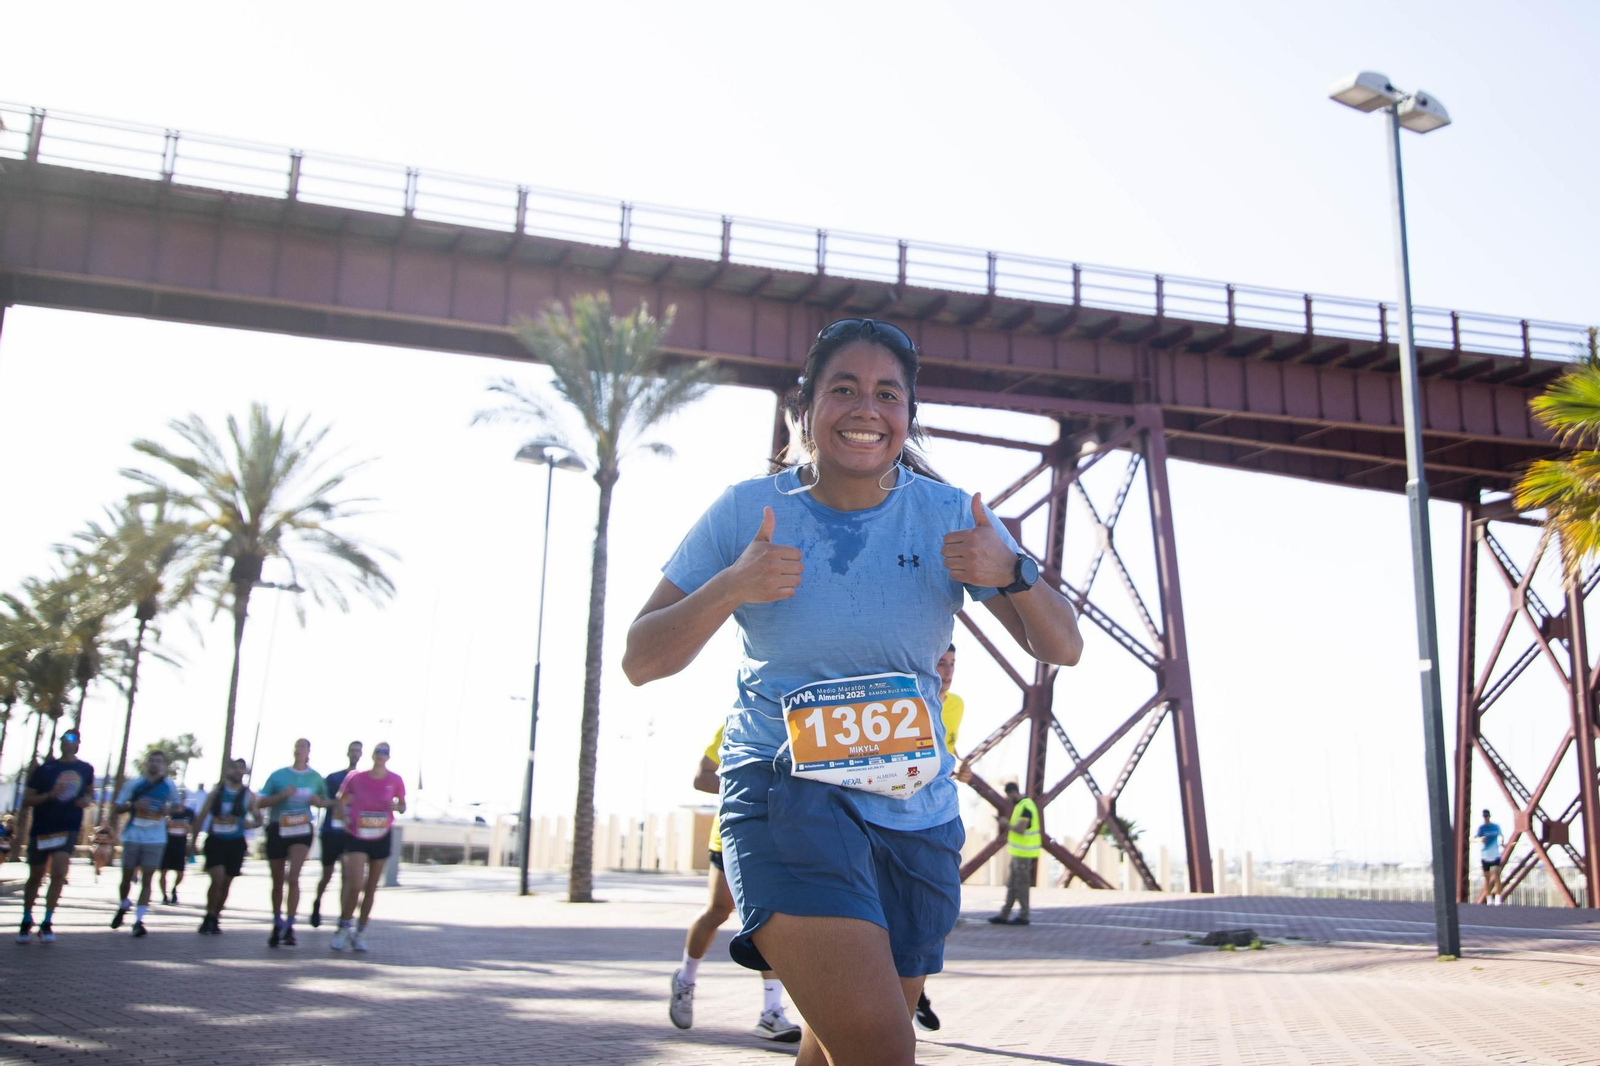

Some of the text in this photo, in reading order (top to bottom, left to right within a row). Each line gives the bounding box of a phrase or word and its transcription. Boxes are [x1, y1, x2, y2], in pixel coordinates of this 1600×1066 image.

[838, 685, 866, 693] Maratón
[818, 690, 866, 701] Almería 2025
[804, 699, 921, 748] 1362
[849, 744, 880, 754] MIKYLA
[841, 777, 863, 786] NEXAL
